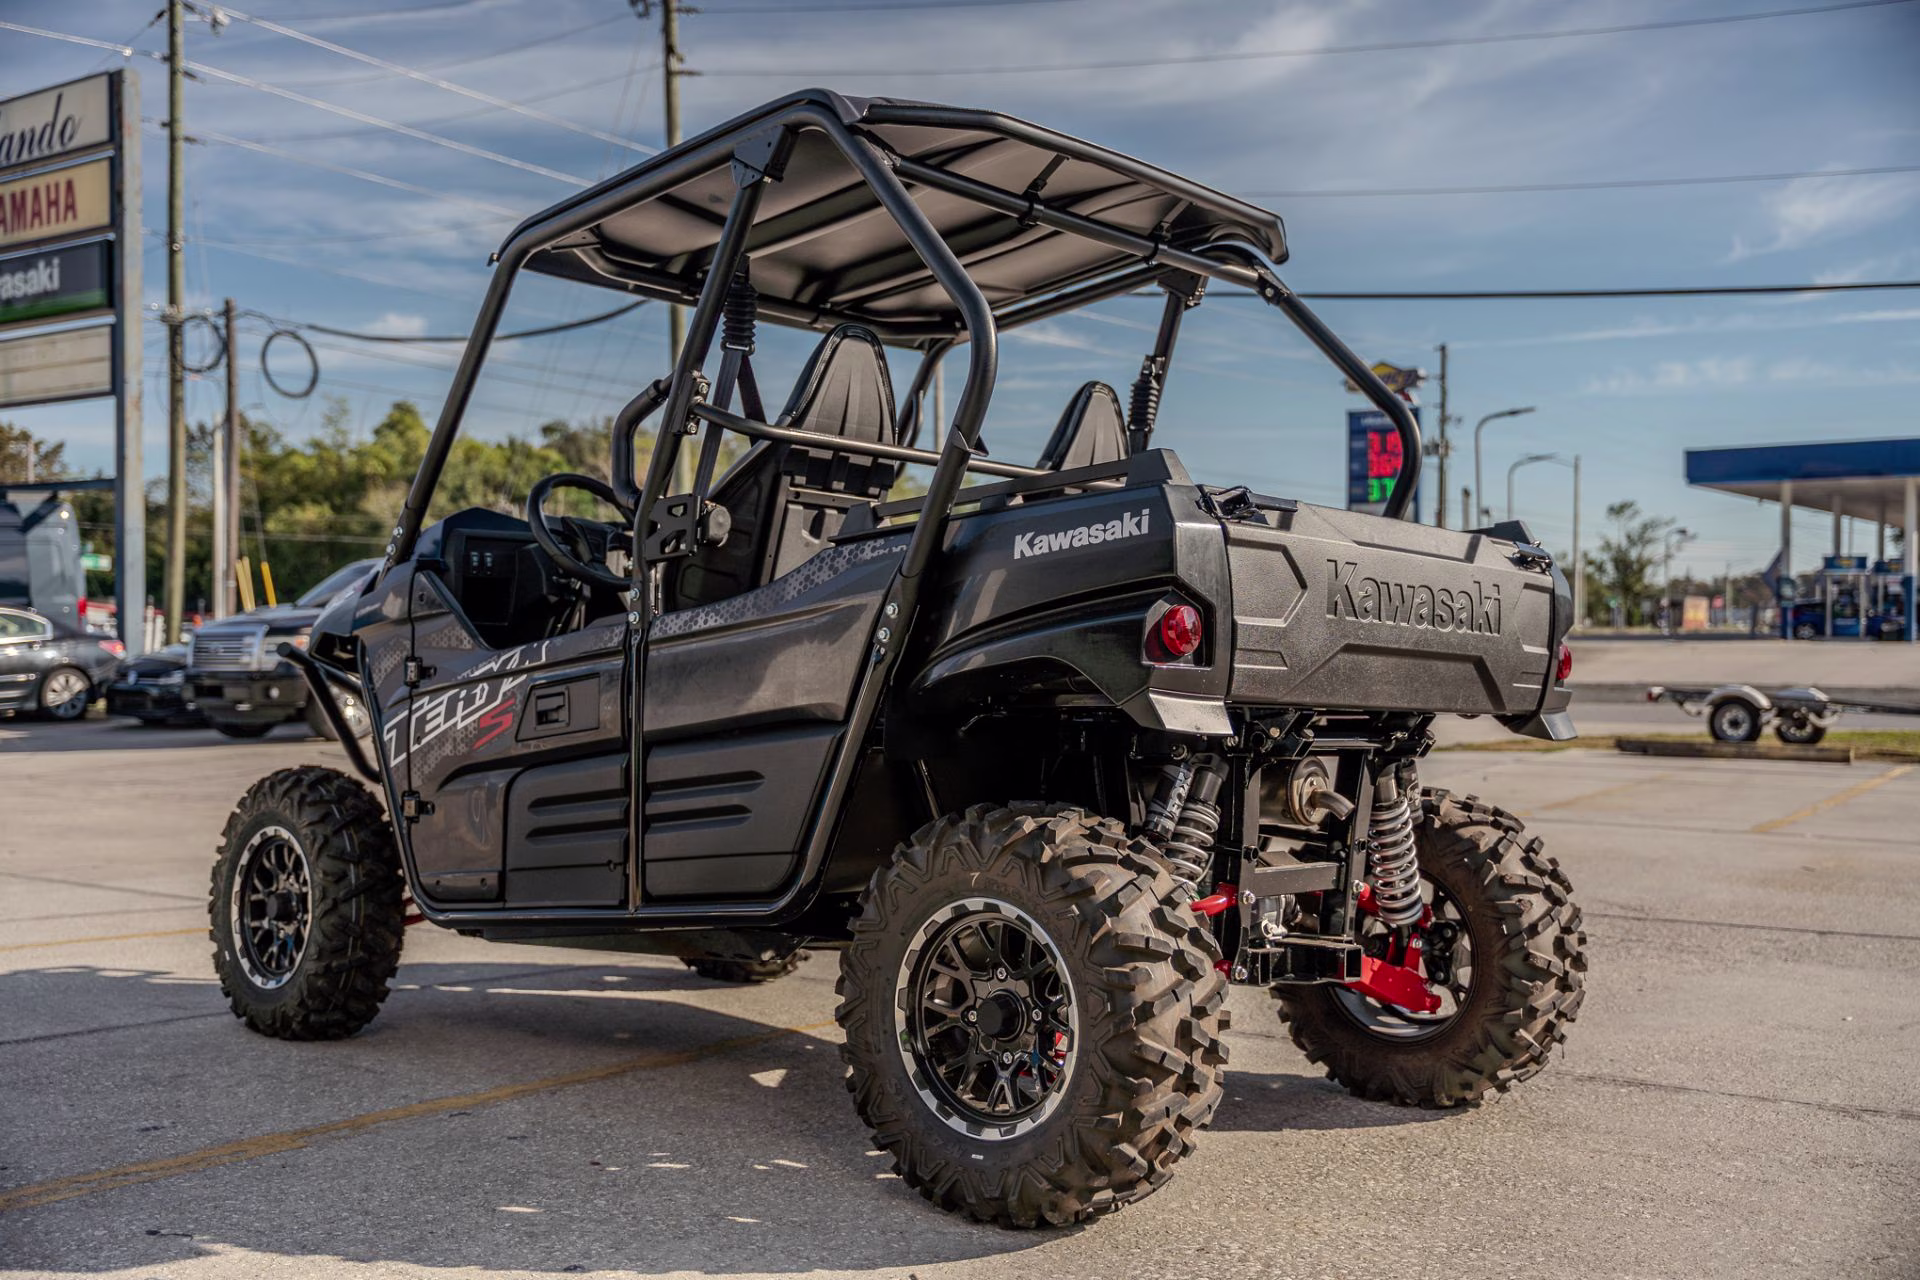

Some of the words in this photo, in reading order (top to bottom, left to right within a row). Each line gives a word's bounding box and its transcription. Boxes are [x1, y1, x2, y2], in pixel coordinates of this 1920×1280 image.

[0, 91, 81, 161] ando
[1013, 507, 1150, 560] Kawasaki
[1325, 558, 1501, 637] Kawasaki
